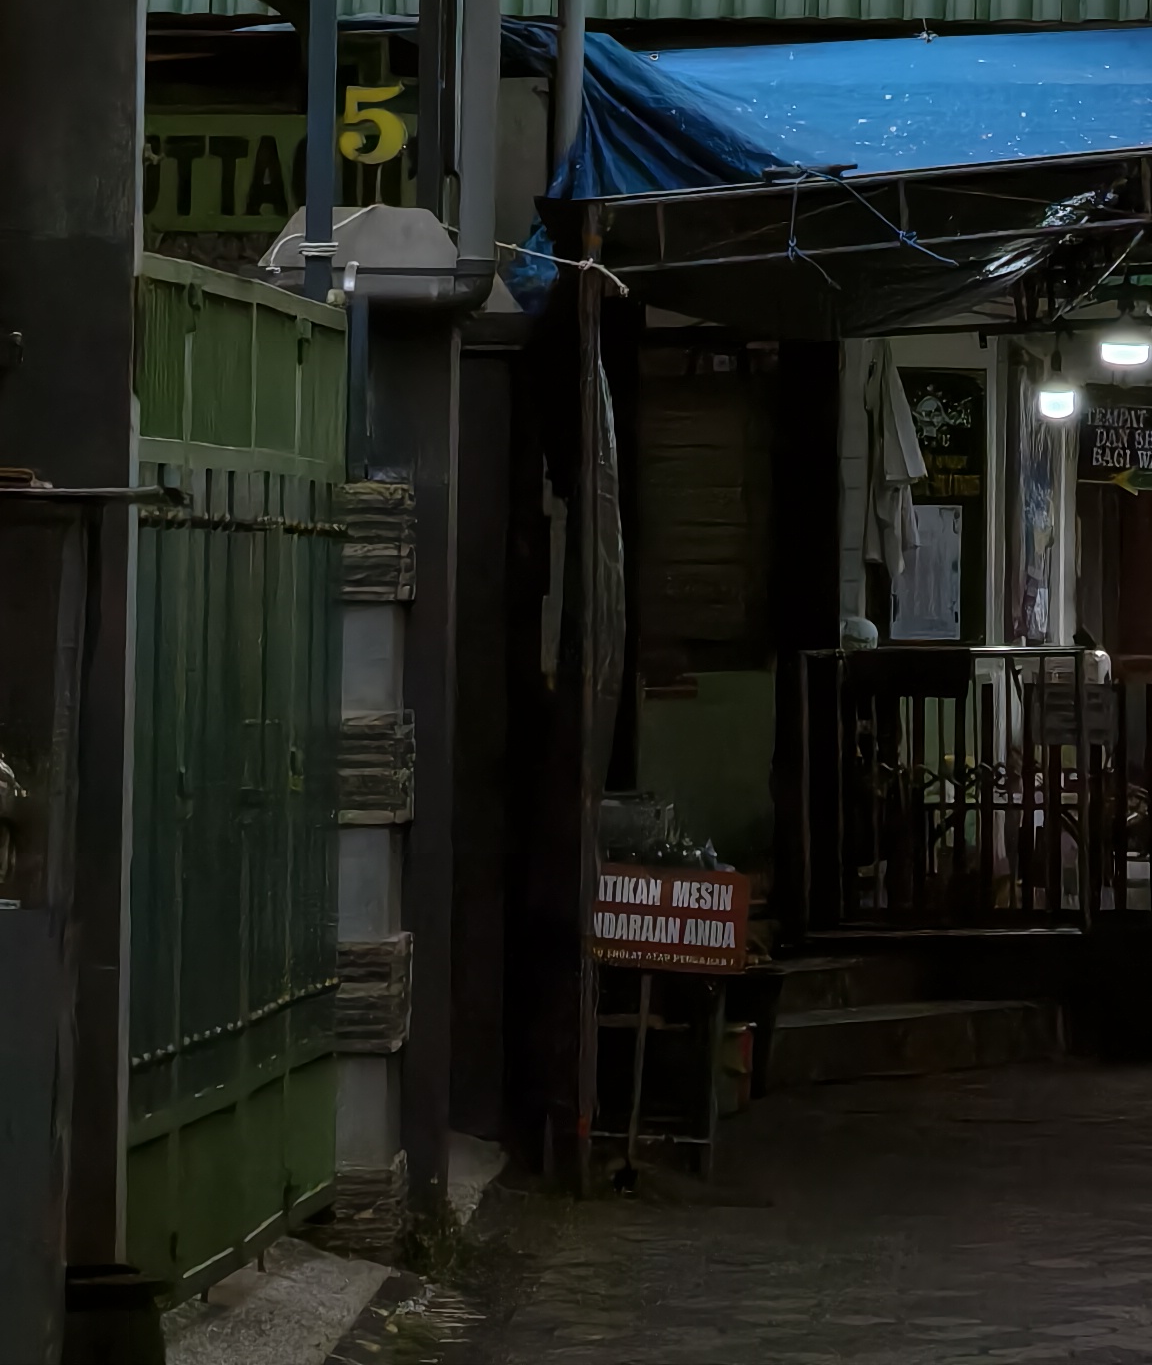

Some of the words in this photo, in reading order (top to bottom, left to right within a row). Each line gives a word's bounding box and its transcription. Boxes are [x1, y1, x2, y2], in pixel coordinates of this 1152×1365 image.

[338, 82, 405, 164] 5
[1086, 407, 1147, 428] TEMPAT
[1095, 428, 1130, 448] DAN
[1092, 446, 1131, 468] BAGI
[671, 880, 734, 912] MESIN
[683, 917, 736, 949] ANDA
